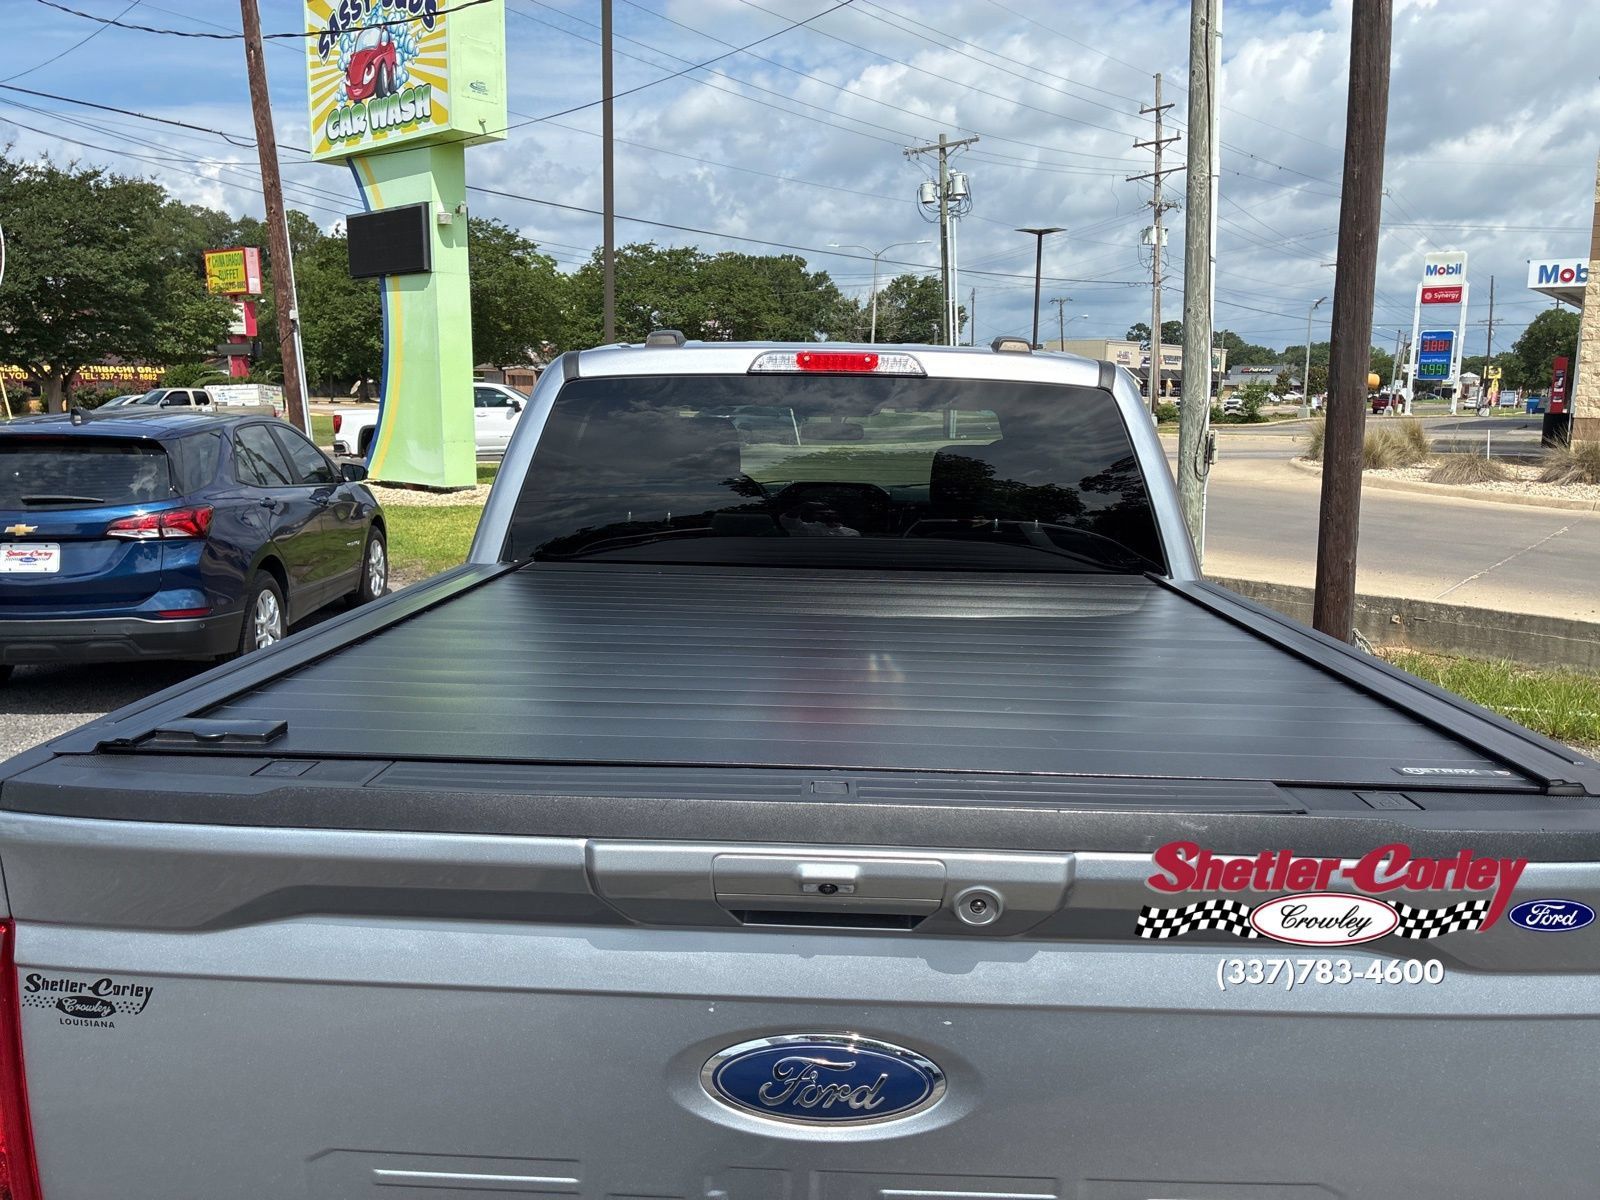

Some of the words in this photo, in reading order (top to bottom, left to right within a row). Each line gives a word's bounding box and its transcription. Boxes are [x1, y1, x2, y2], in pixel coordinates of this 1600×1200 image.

[326, 102, 368, 144] CAR
[368, 83, 432, 134] WASH
[218, 268, 239, 281] BUFFET
[1425, 263, 1462, 276] Mobil
[9, 372, 28, 380] YOU
[23, 973, 154, 1015] Shetler-Corley
[62, 997, 111, 1016] Crowley
[59, 1017, 115, 1028] LOUISIANA
[758, 1056, 889, 1110] Ford
